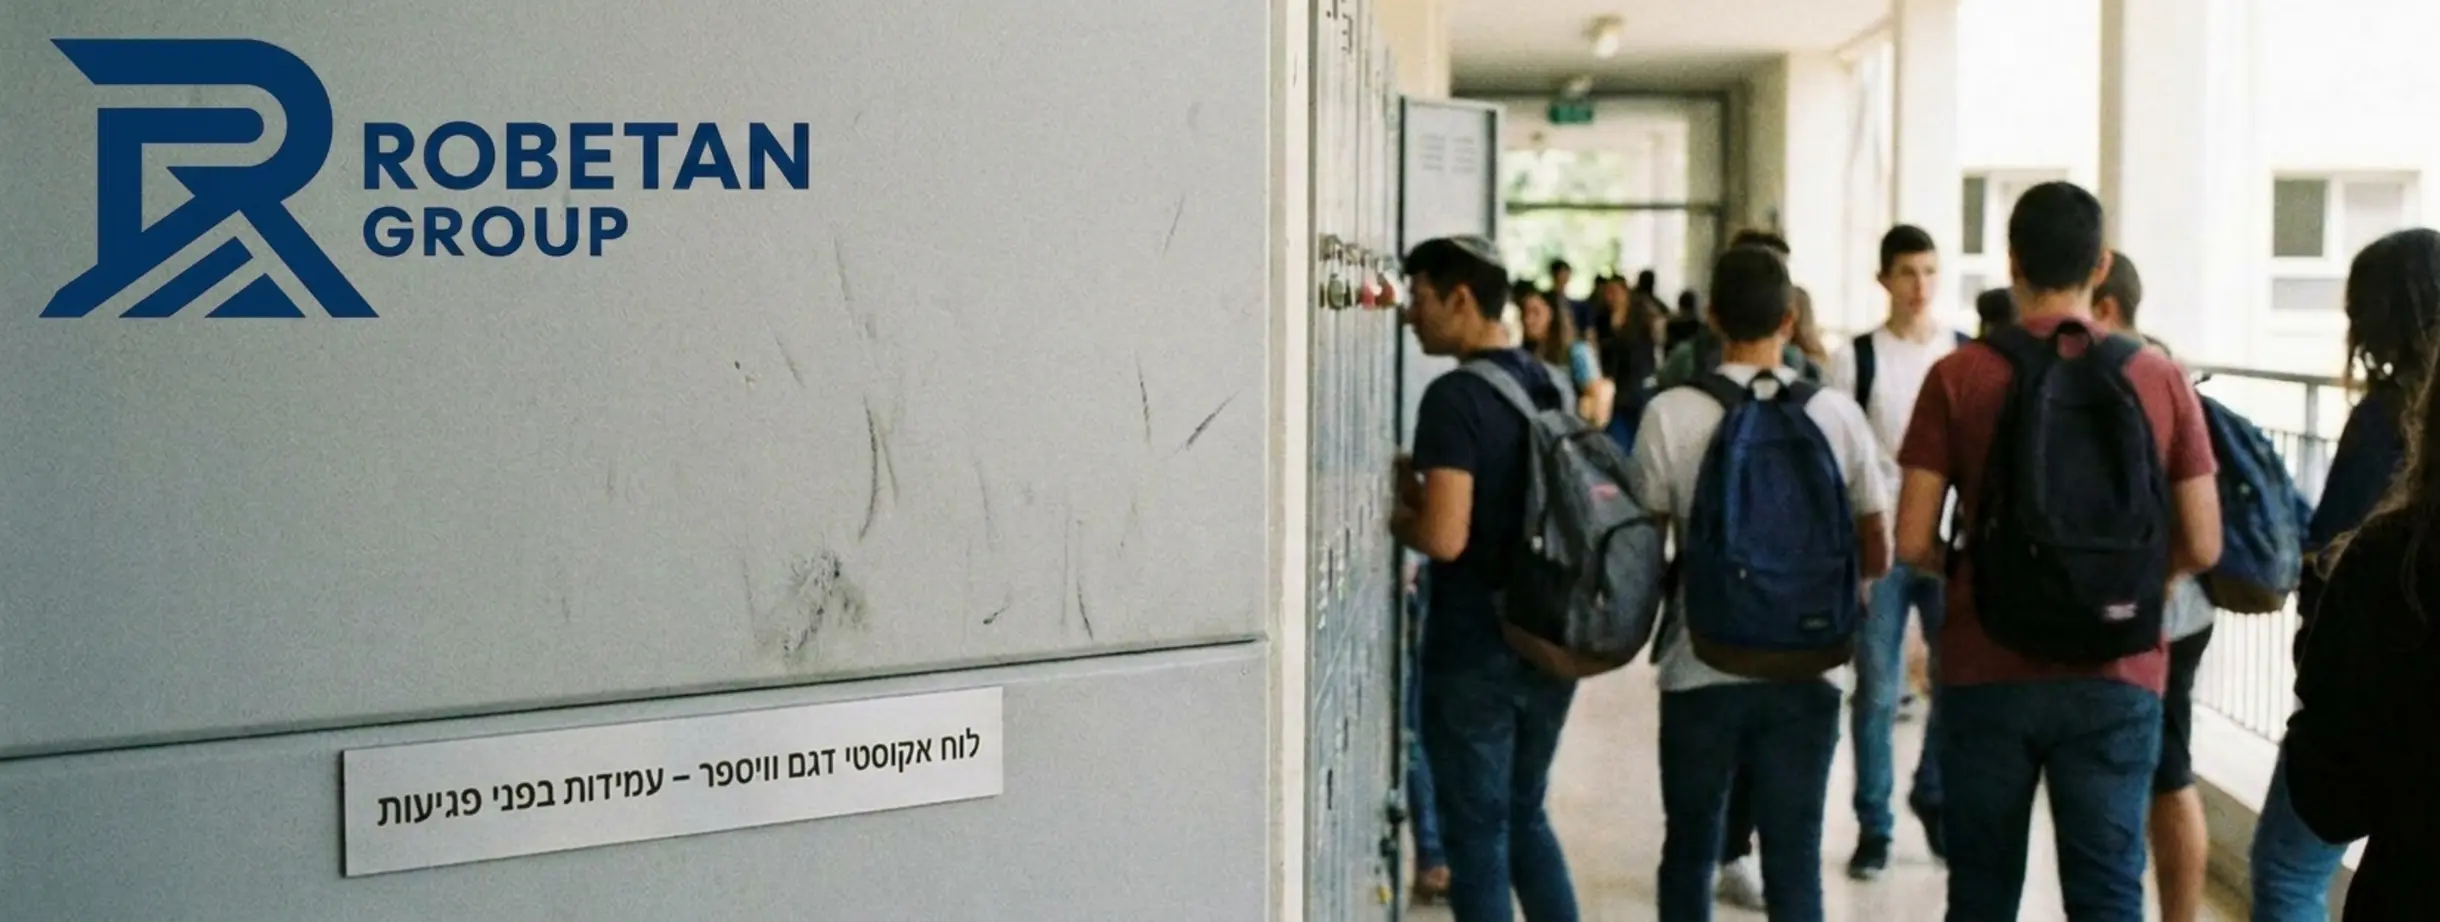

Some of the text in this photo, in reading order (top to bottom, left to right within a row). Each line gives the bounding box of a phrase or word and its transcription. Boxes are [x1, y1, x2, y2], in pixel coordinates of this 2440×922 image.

[845, 738, 932, 773] אקוסטי
[940, 727, 981, 761] לוח
[698, 754, 779, 788] וויספר
[788, 748, 836, 779] דגם
[492, 779, 556, 812] בפני
[563, 767, 664, 805] עמידות
[376, 787, 482, 827] פגיעות
